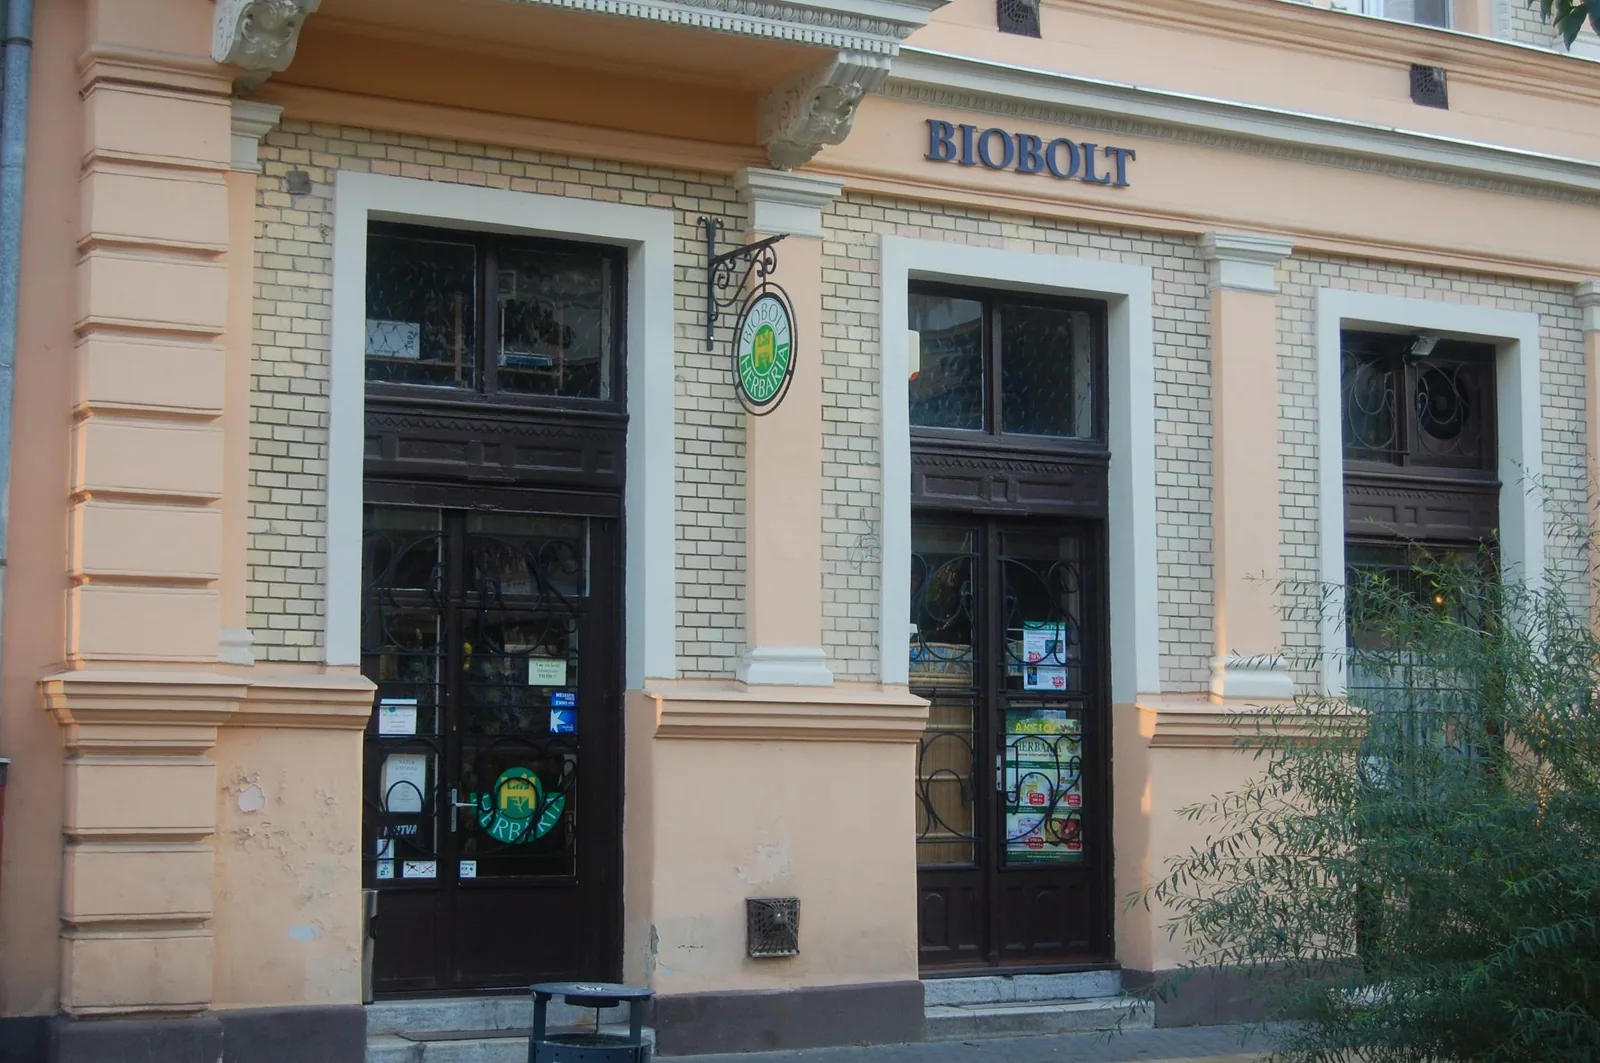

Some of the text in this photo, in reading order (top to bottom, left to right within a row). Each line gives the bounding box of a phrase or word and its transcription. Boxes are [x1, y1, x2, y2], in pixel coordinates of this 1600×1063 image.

[924, 119, 1136, 187] BIOBOLT
[743, 303, 789, 345] BIOBOLT
[741, 346, 789, 398] HERBÁRIA
